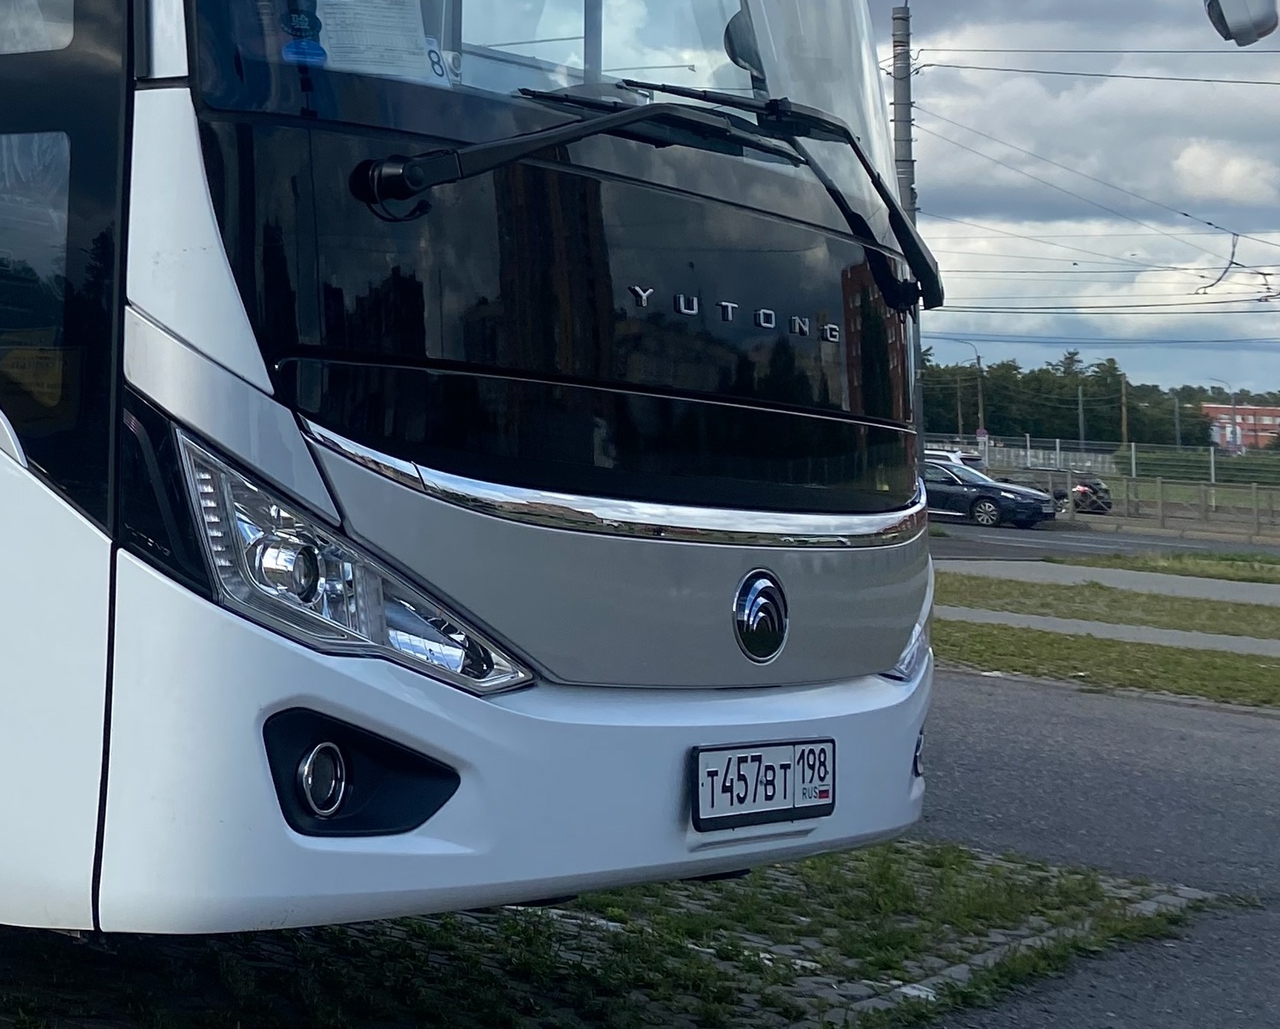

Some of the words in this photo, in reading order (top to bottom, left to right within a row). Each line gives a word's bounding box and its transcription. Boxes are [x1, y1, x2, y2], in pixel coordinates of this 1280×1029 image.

[628, 284, 840, 343] YUTONG
[796, 747, 828, 785] 198
[802, 786, 818, 800] RUS
